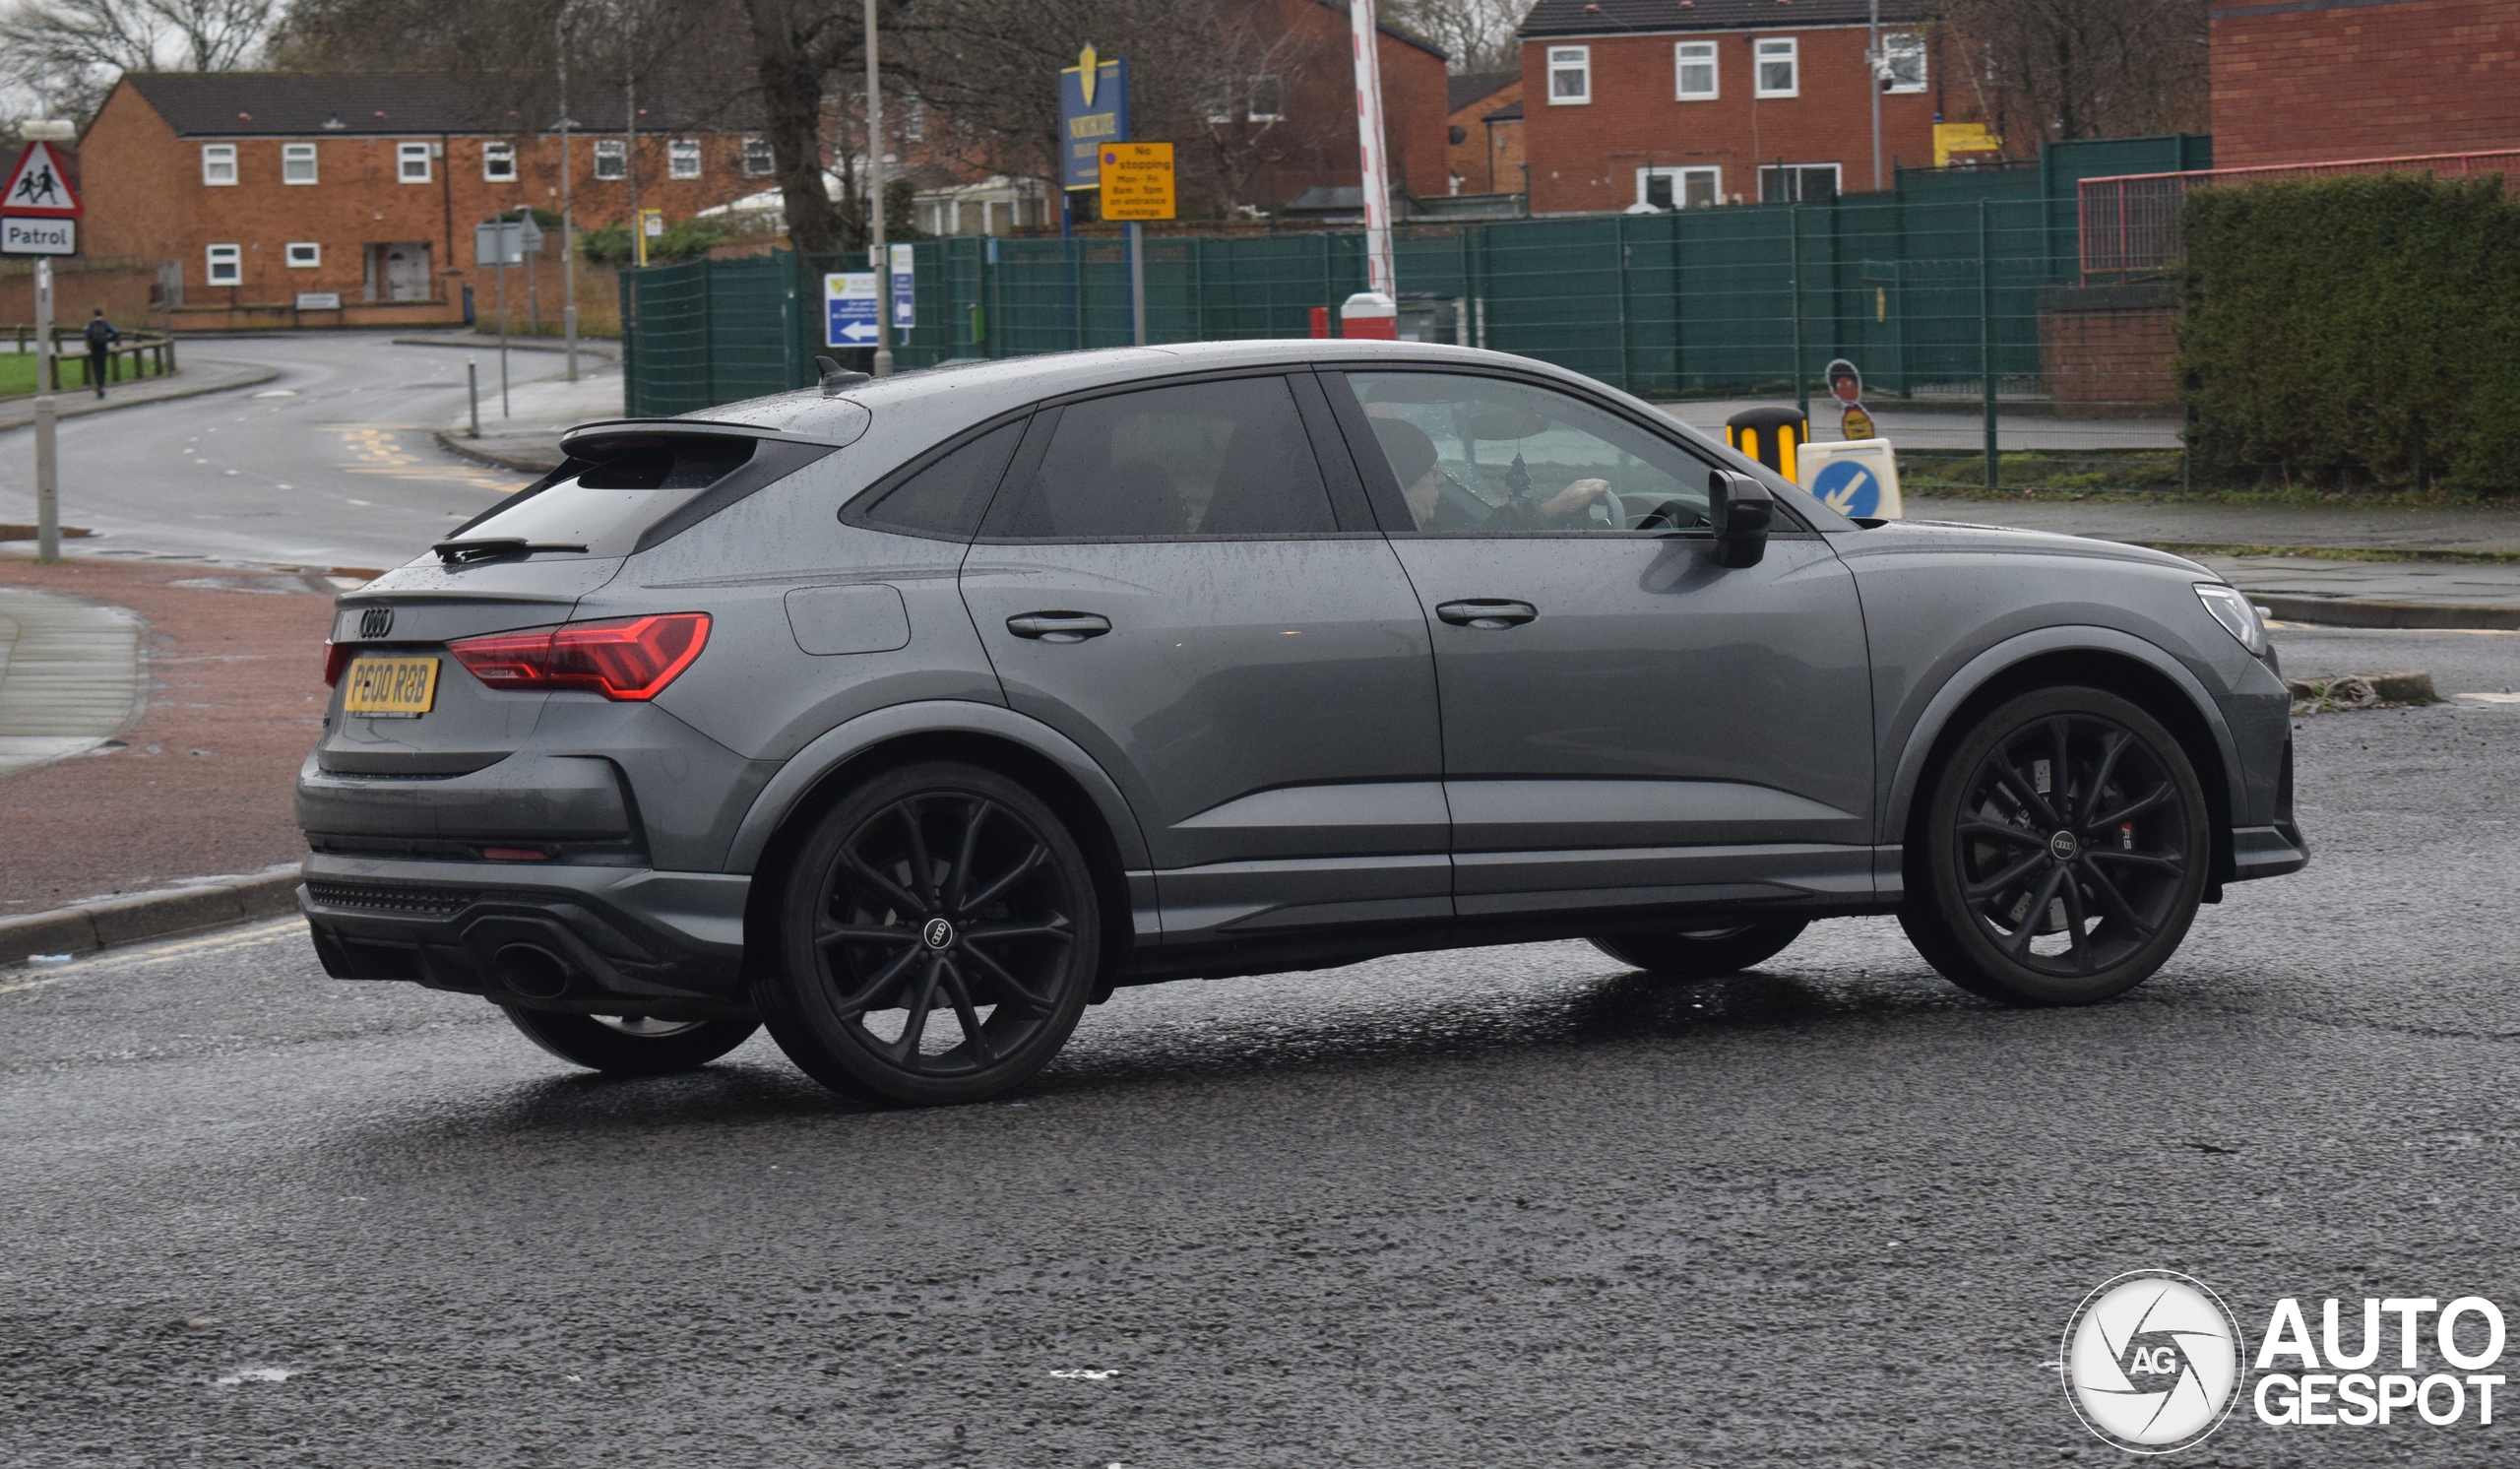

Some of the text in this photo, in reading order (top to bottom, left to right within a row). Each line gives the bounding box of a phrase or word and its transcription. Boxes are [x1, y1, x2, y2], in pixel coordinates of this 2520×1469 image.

[1135, 146, 1152, 156] No
[1120, 160, 1170, 171] stopping
[1147, 174, 1160, 183] Fri
[1117, 209, 1161, 218] markings
[9, 226, 67, 245] Patrol
[2121, 827, 2132, 850] RS
